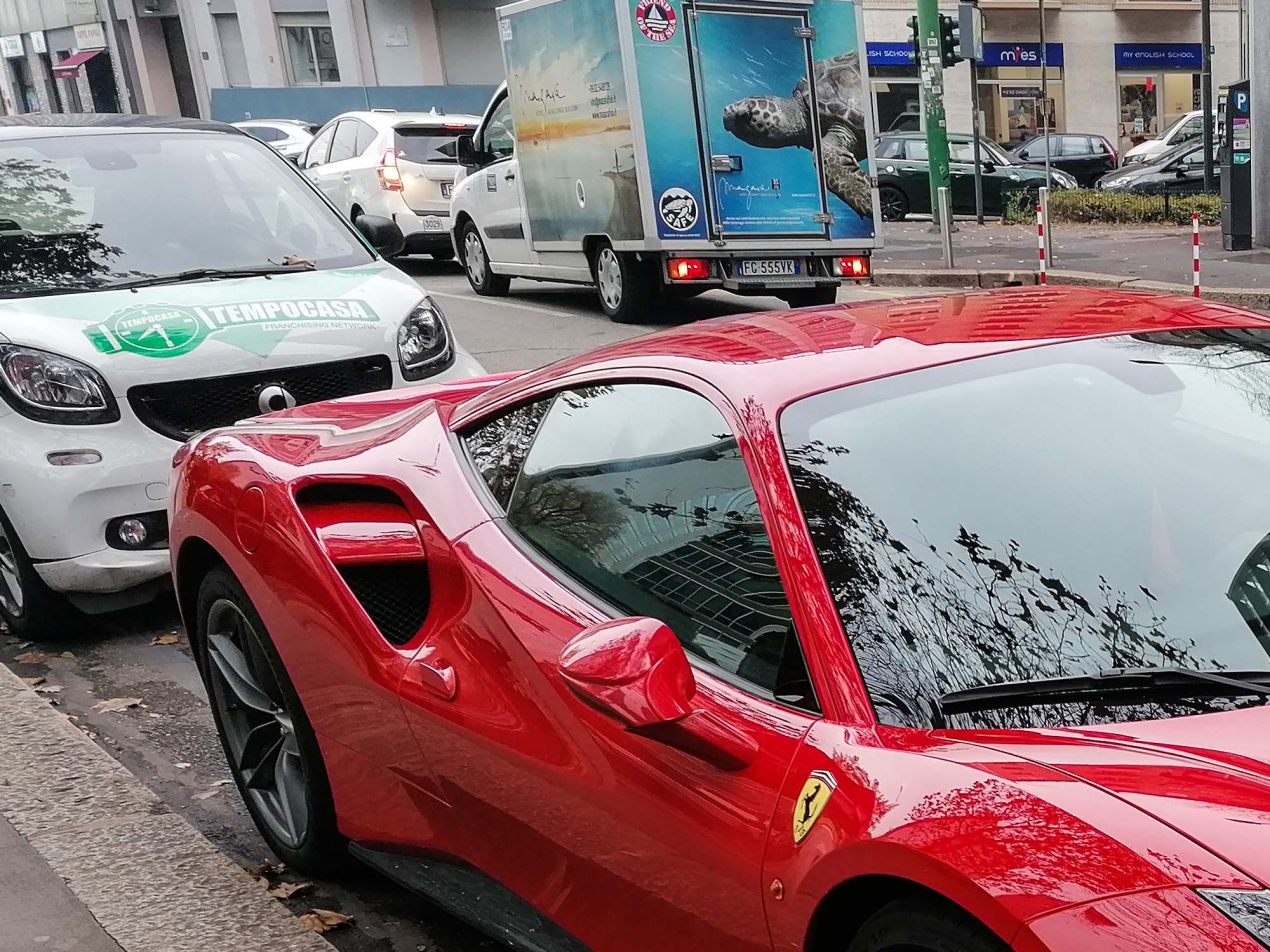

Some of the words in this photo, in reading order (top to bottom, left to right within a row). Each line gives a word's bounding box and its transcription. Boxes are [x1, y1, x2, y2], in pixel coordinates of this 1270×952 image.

[666, 213, 694, 228] SAFE
[120, 311, 181, 328] TEMPOCASA
[206, 300, 370, 325] TEMPOCASA
[264, 321, 329, 331] FRANCHISING
[330, 321, 377, 330] NETWORK
